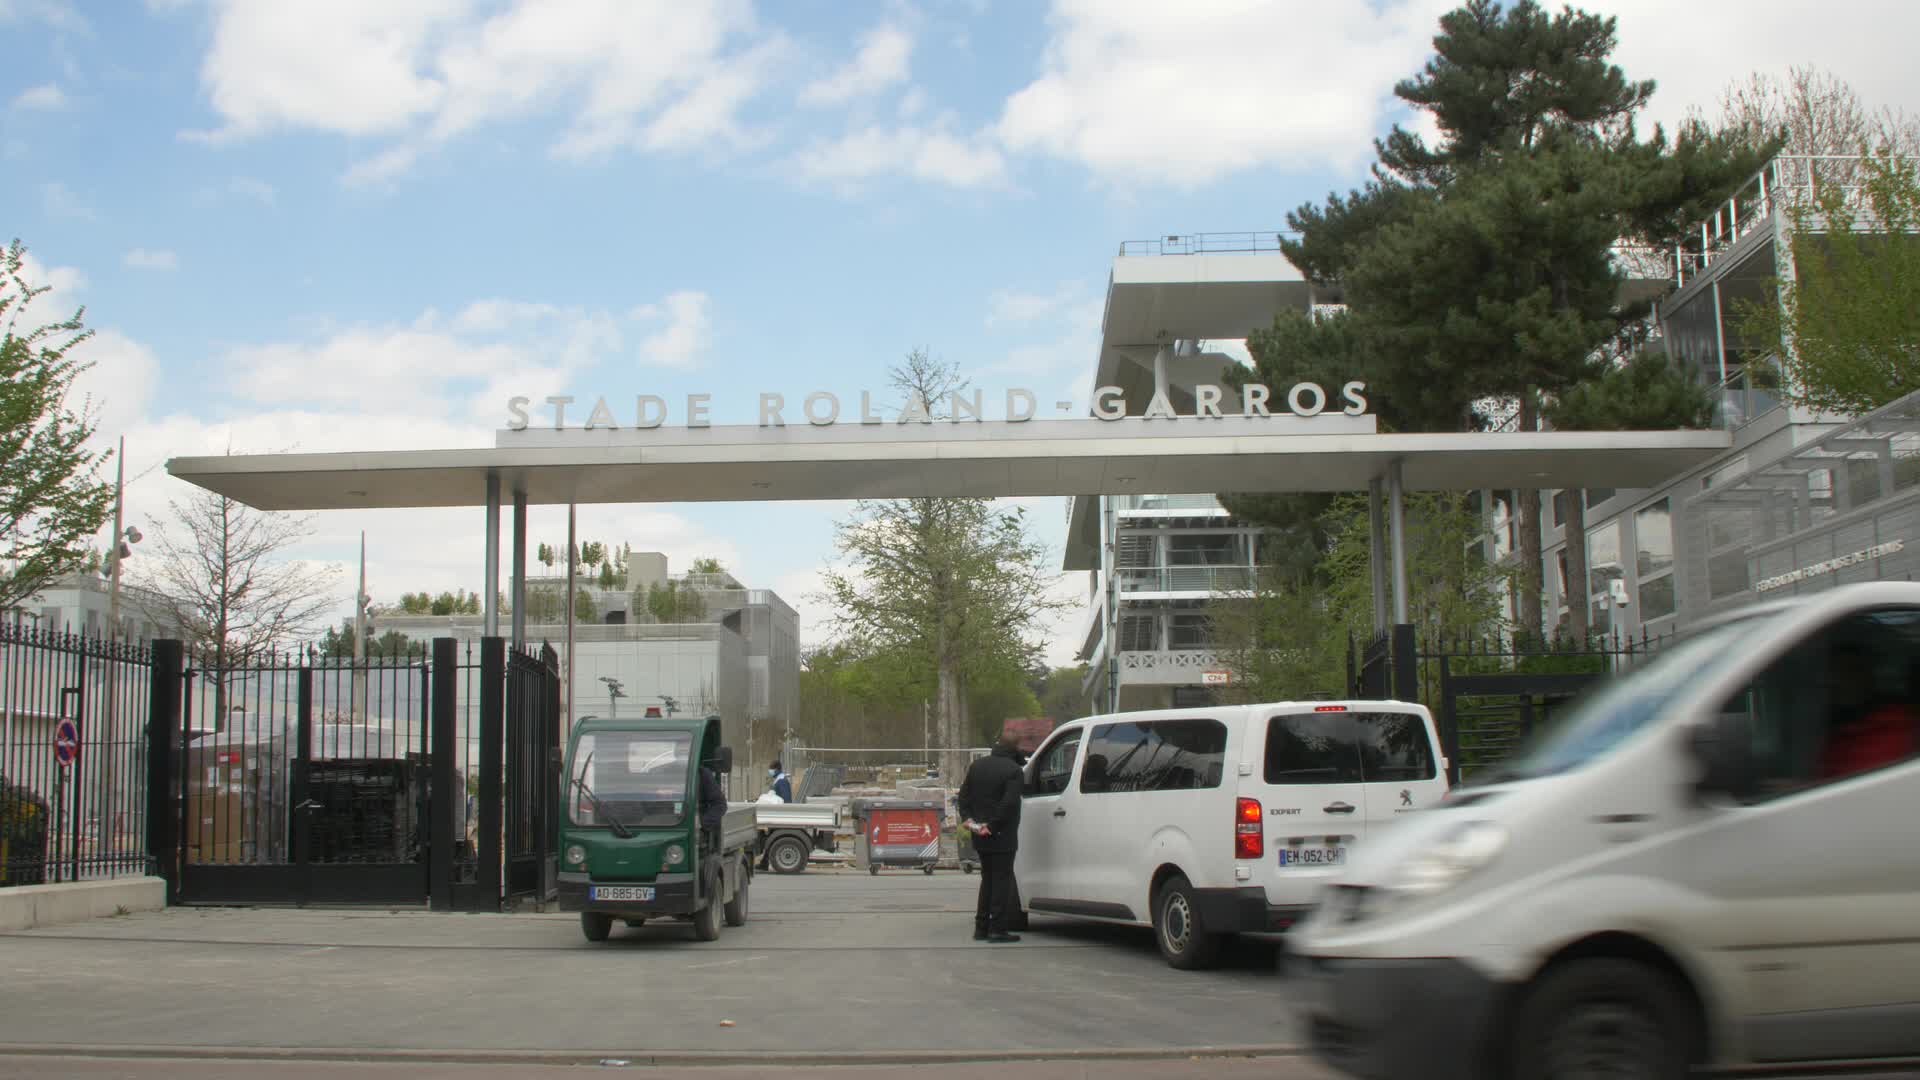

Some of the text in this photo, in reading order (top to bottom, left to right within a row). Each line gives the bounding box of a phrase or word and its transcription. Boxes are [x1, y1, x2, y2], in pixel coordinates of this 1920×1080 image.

[506, 381, 1368, 430] STADE ROLAND-GARROS
[1270, 808, 1302, 816] EXPERT
